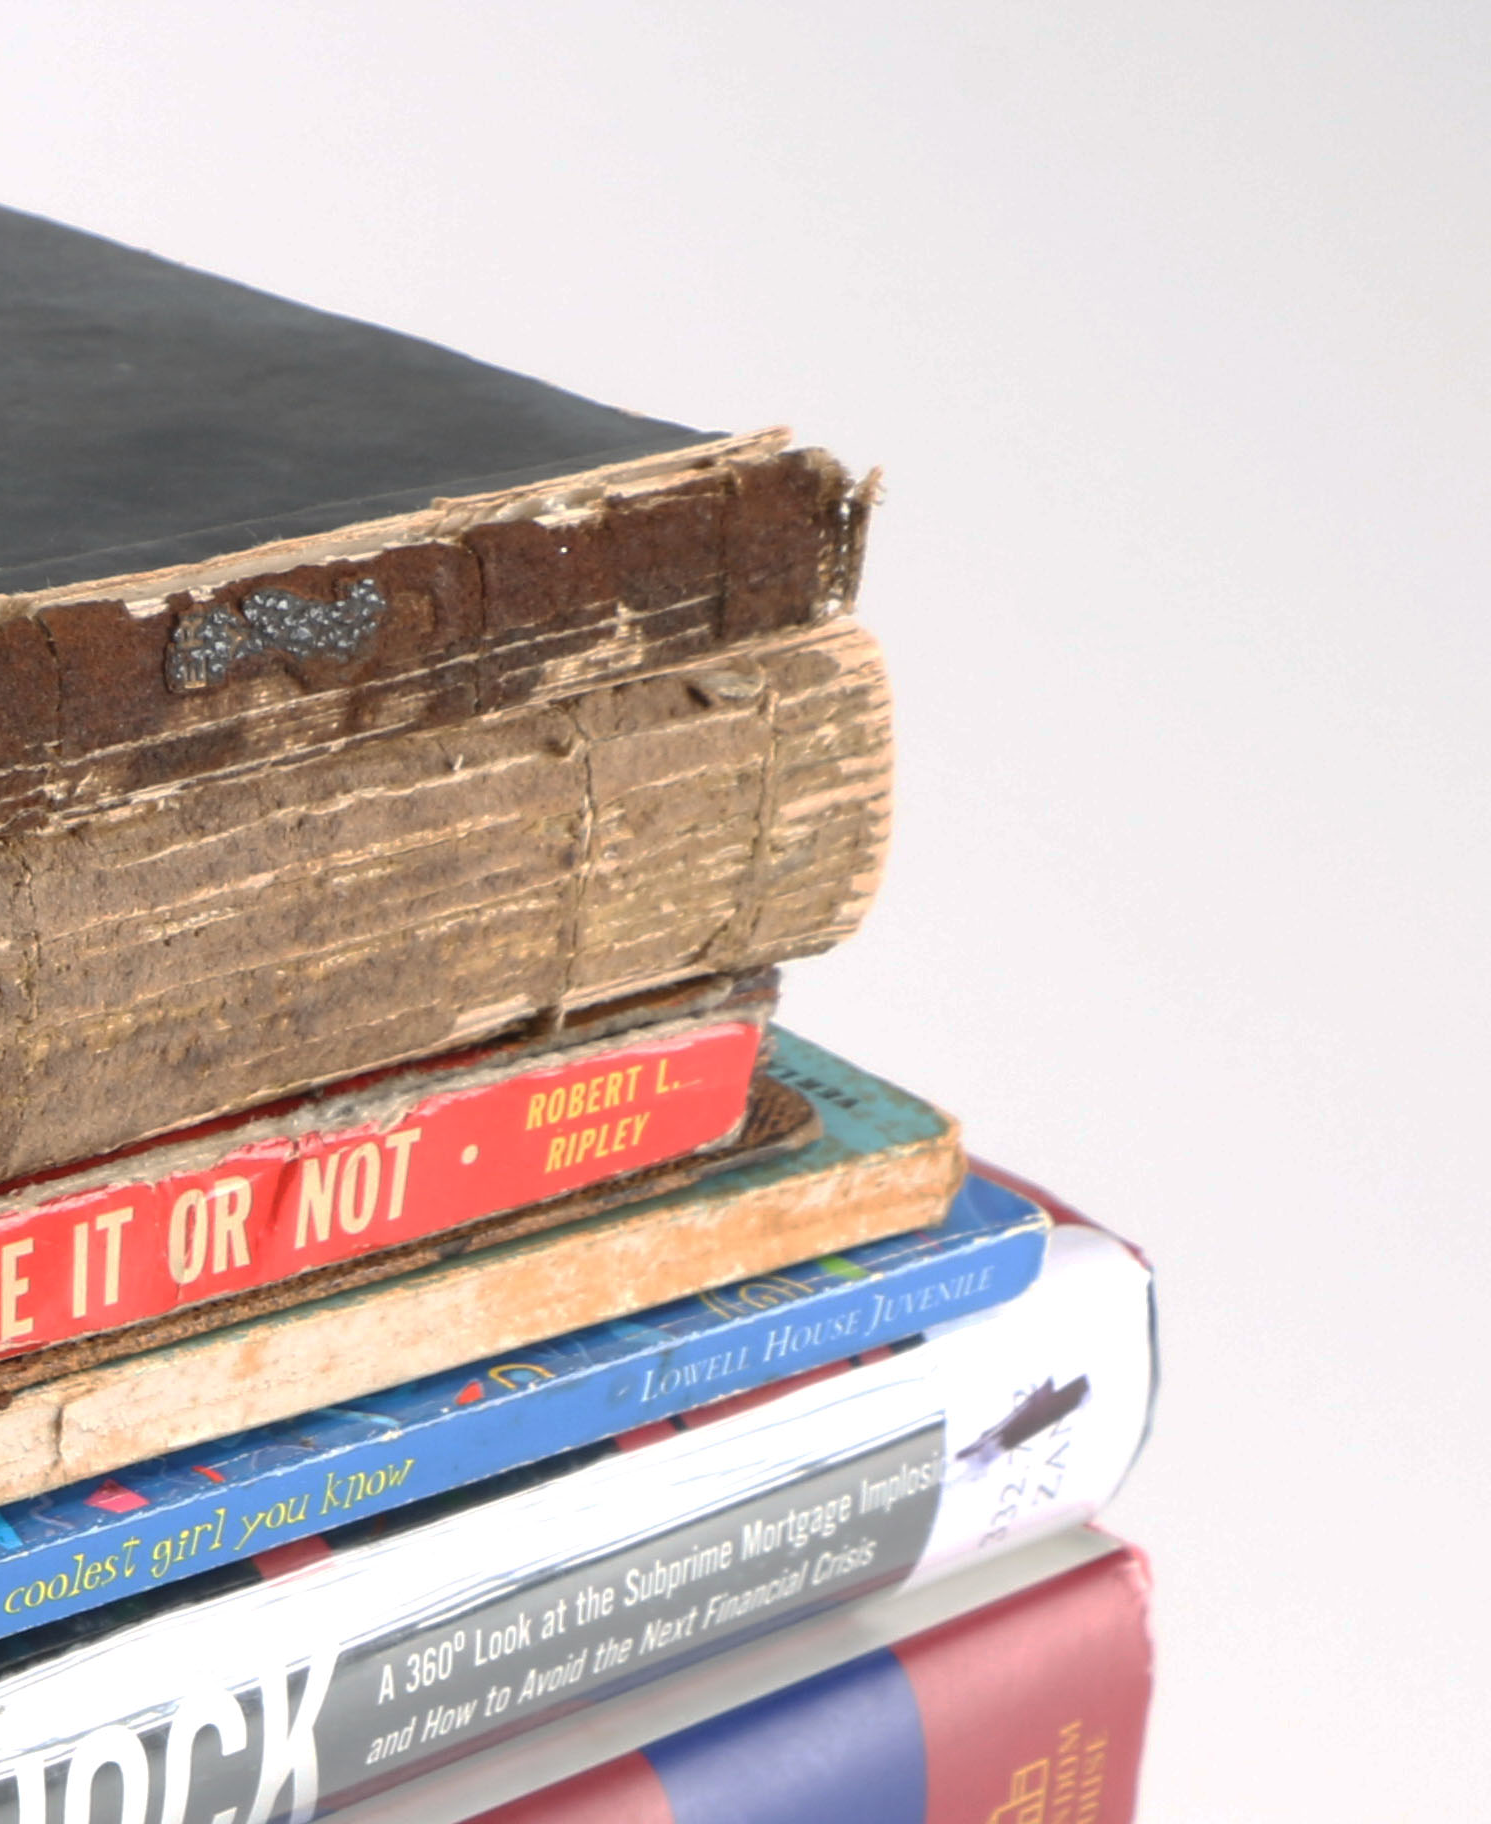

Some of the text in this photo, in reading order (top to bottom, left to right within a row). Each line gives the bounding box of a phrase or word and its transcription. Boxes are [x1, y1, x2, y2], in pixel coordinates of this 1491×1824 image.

[524, 1059, 682, 1132] ROBERT L.
[544, 1113, 651, 1174] RIPLEY
[72, 1206, 133, 1317] IT
[169, 1177, 252, 1285] OR
[294, 1128, 421, 1243] NOT
[5, 1533, 140, 1614] coolest
[150, 1507, 224, 1576] girl
[235, 1494, 307, 1550] you
[319, 1453, 415, 1521] know
[379, 1664, 396, 1705] A
[474, 1614, 531, 1666] Look
[540, 1599, 567, 1638] at
[574, 1575, 615, 1625] the
[623, 1533, 733, 1620] Subprime
[740, 1493, 852, 1562] Mortgage
[859, 1450, 945, 1515] Implosi
[366, 1537, 877, 1766] and How to Avoid the Next Financial Crisis
